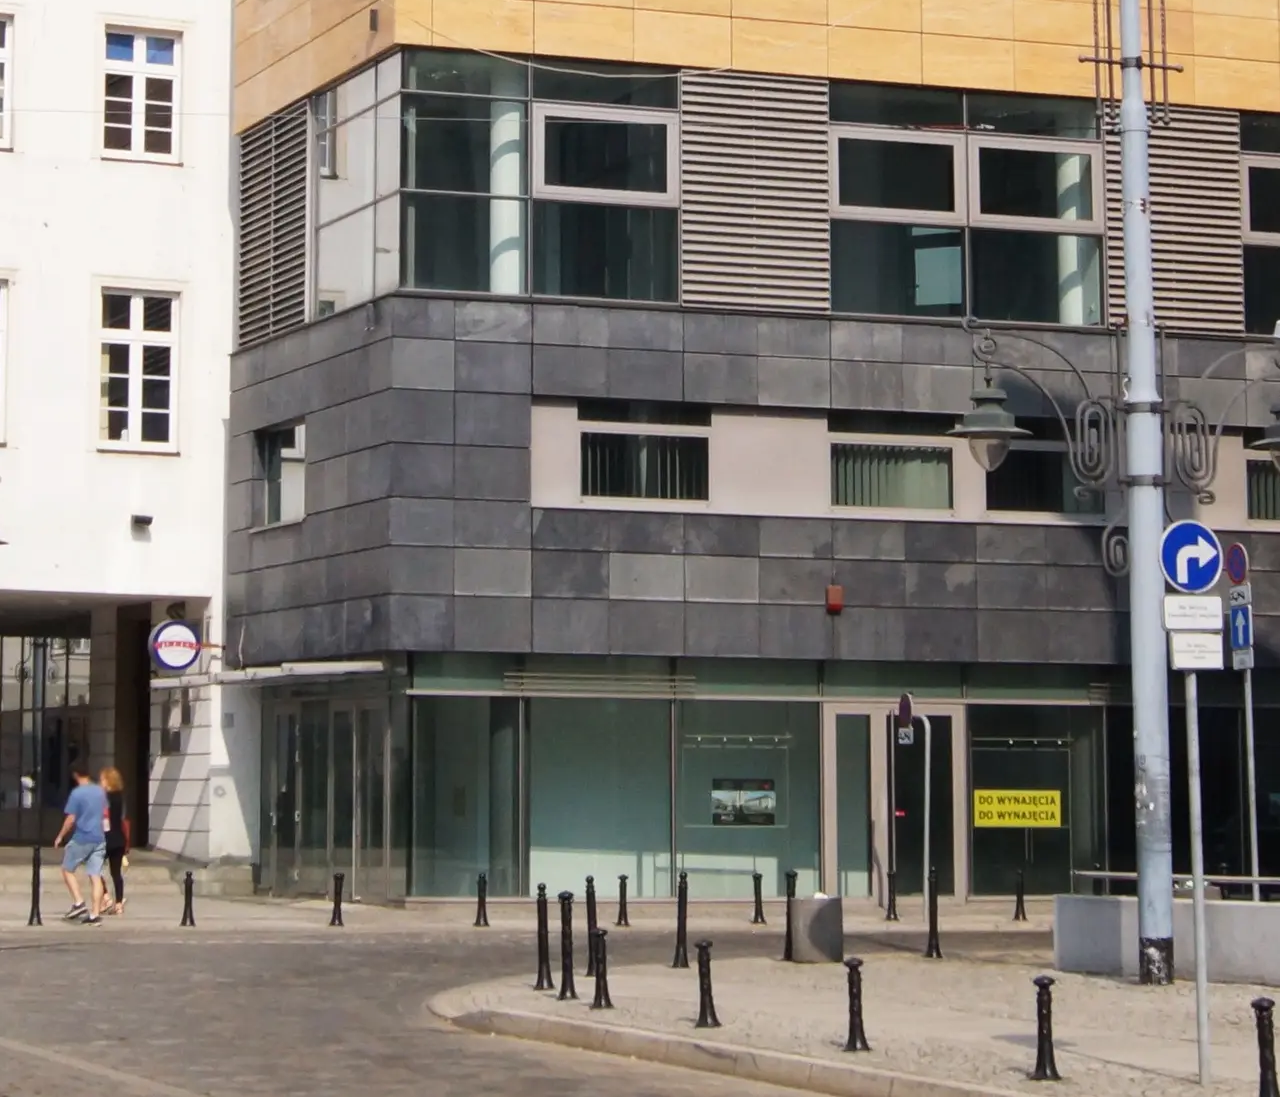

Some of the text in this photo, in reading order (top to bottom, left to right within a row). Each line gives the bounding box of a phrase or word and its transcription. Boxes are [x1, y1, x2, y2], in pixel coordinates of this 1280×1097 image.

[979, 795, 1056, 808] DO WYNAJĘCIA
[979, 811, 1056, 822] DO WYNAJĘCIA
